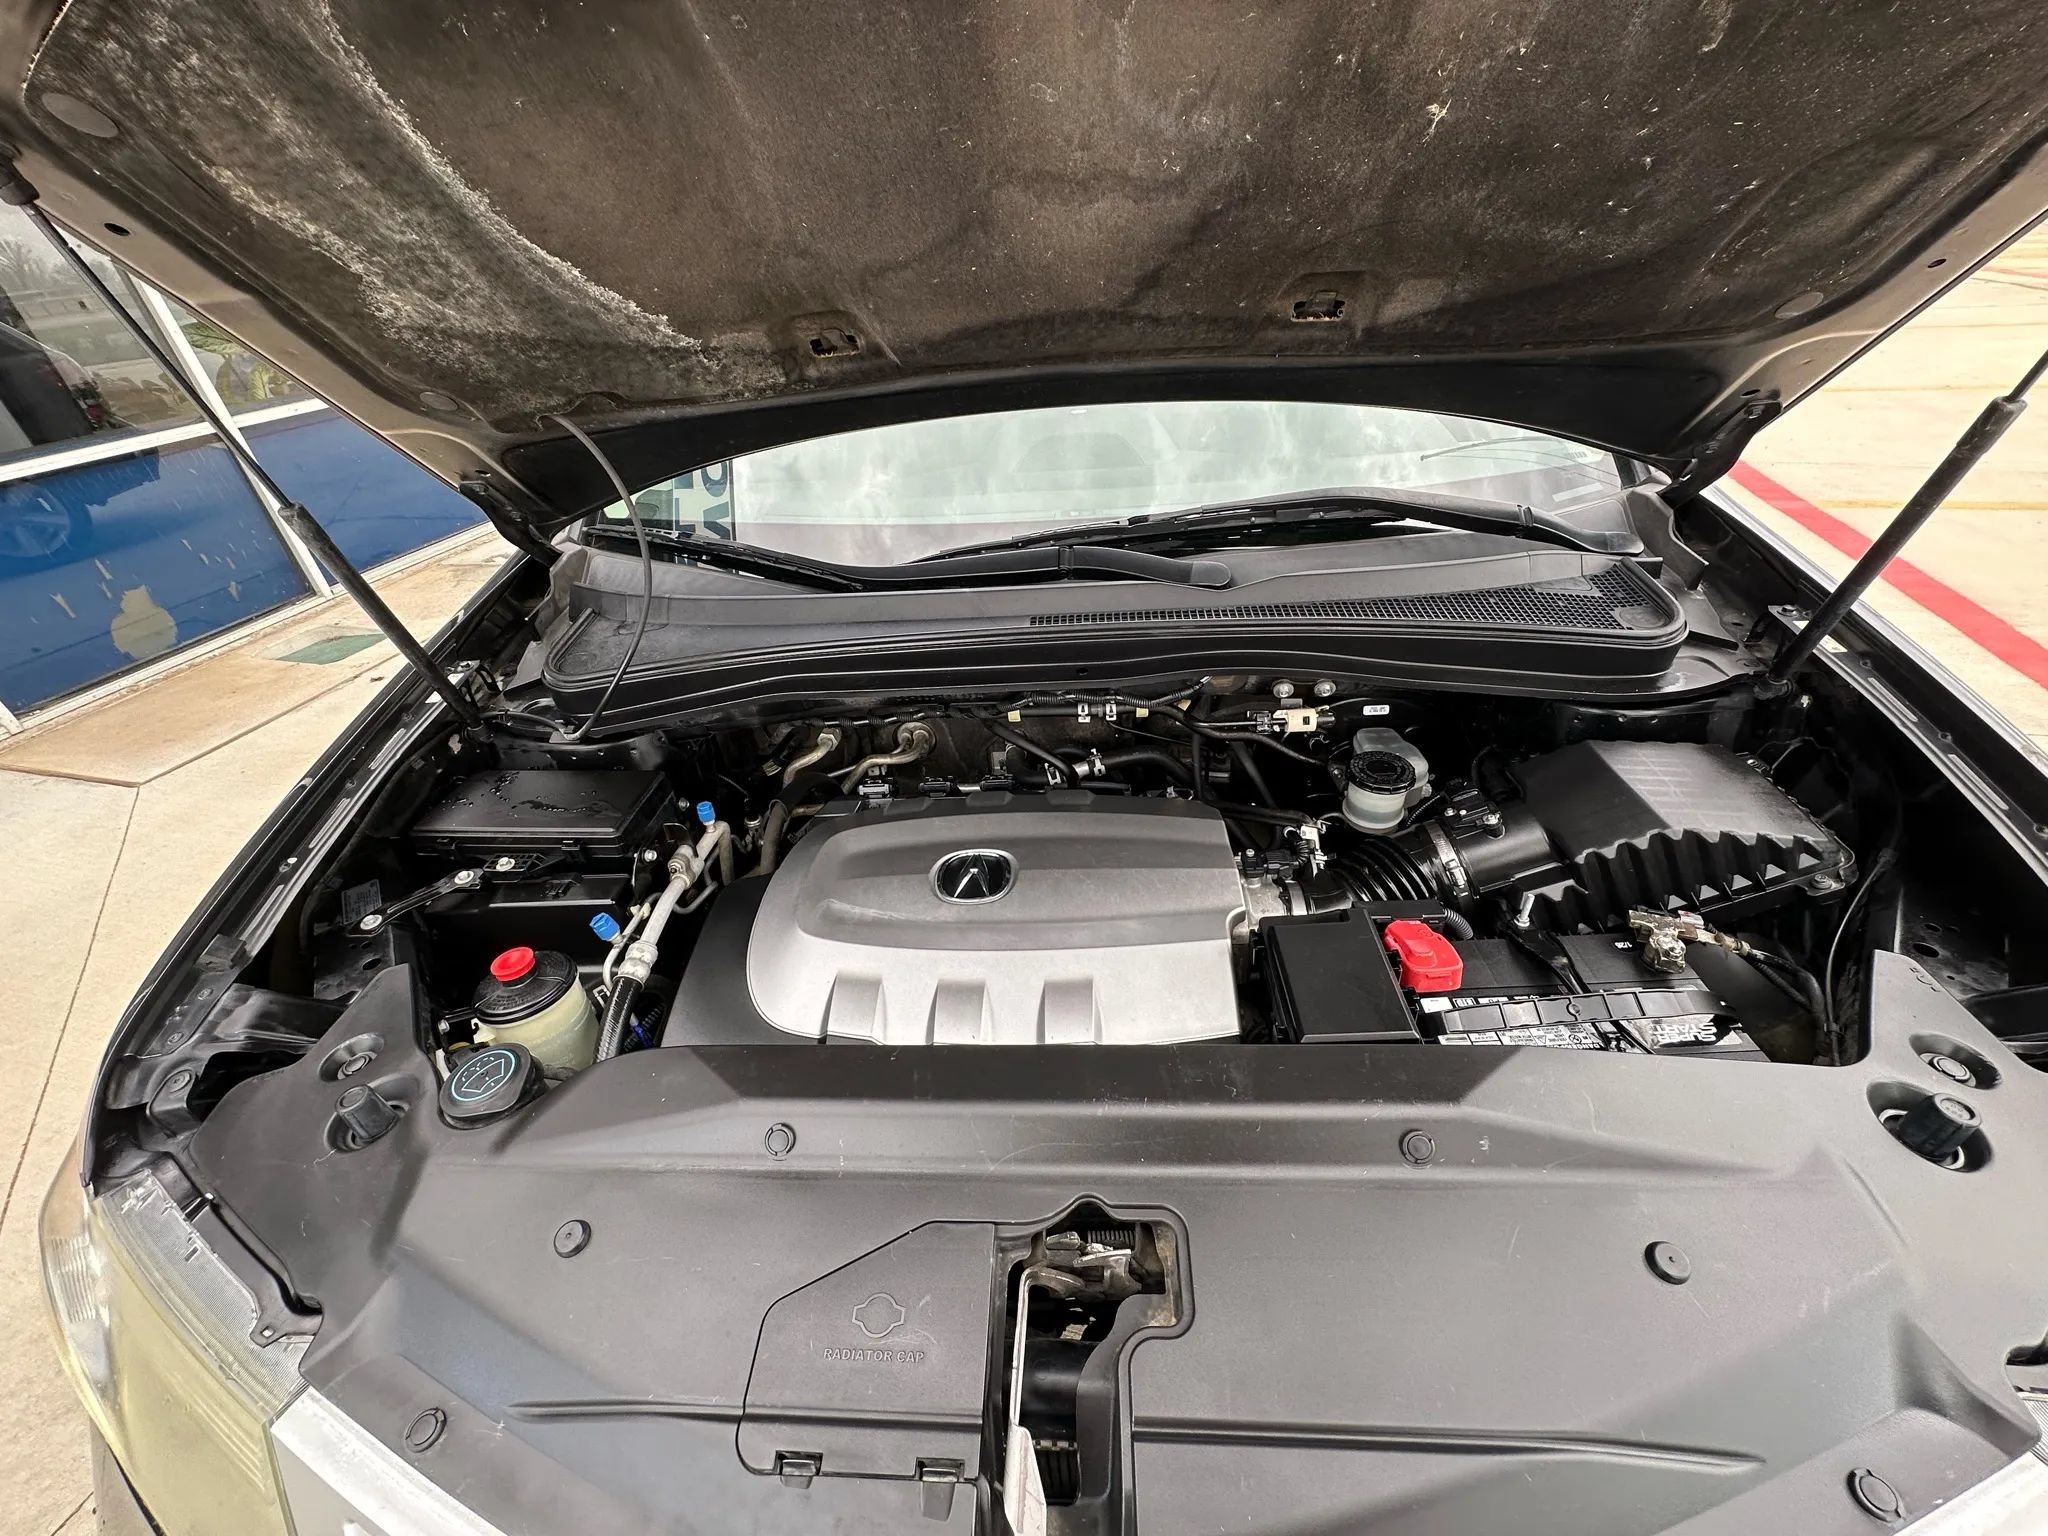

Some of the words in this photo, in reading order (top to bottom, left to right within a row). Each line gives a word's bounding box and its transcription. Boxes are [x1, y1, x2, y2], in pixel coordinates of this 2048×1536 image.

[1653, 1022, 1718, 1036] START
[1658, 1032, 1717, 1042] SUPER
[823, 1348, 893, 1362] RADIATOR
[896, 1350, 925, 1363] CAP
